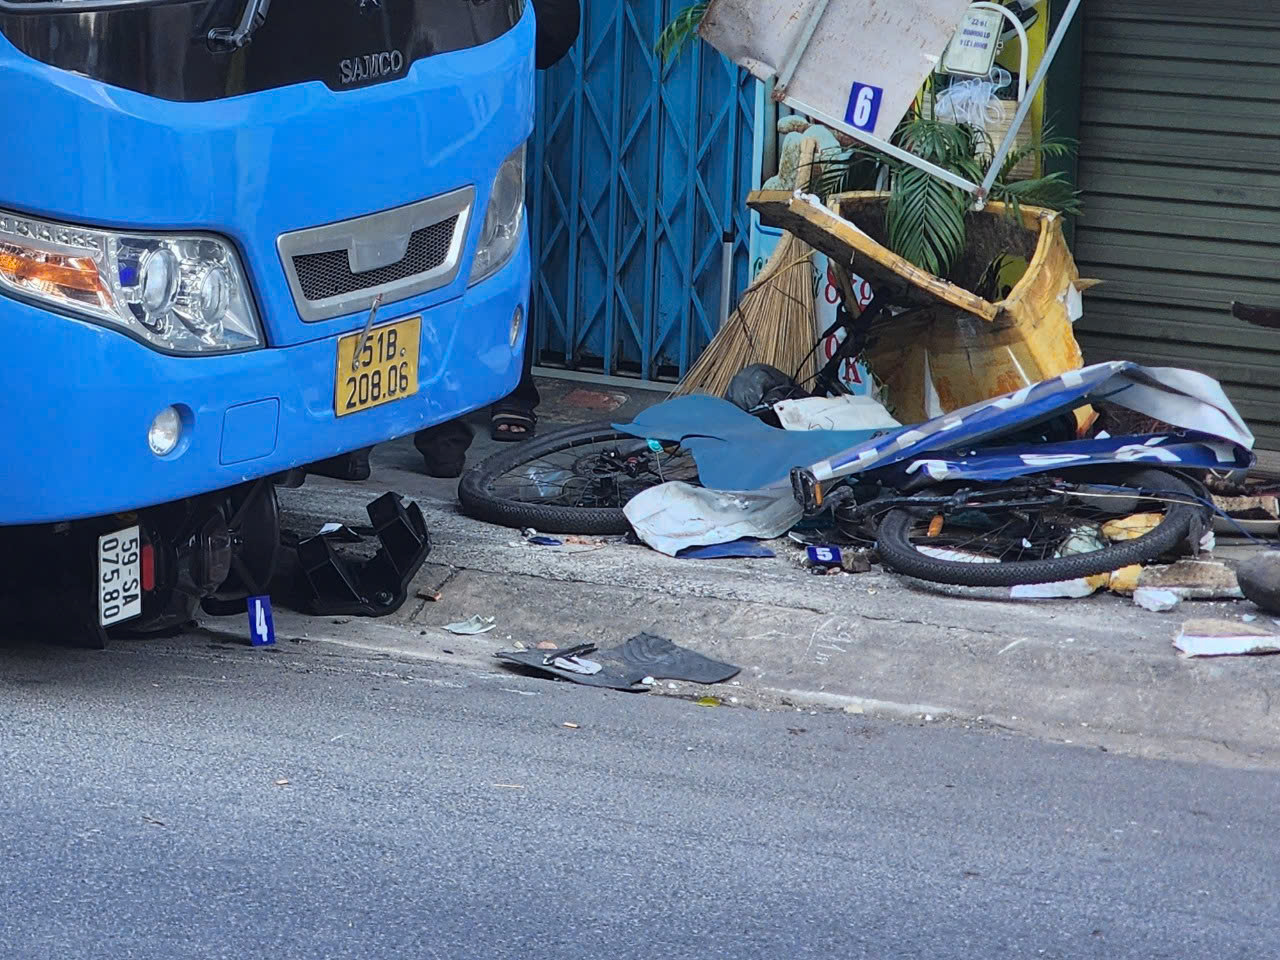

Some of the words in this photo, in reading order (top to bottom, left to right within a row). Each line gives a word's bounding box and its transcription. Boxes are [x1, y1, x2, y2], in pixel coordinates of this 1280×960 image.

[851, 84, 874, 128] 6
[345, 361, 409, 409] 208.06
[121, 536, 140, 607] 59-SA
[817, 546, 833, 562] 5
[101, 537, 120, 620] 075.80
[255, 598, 269, 642] 4
